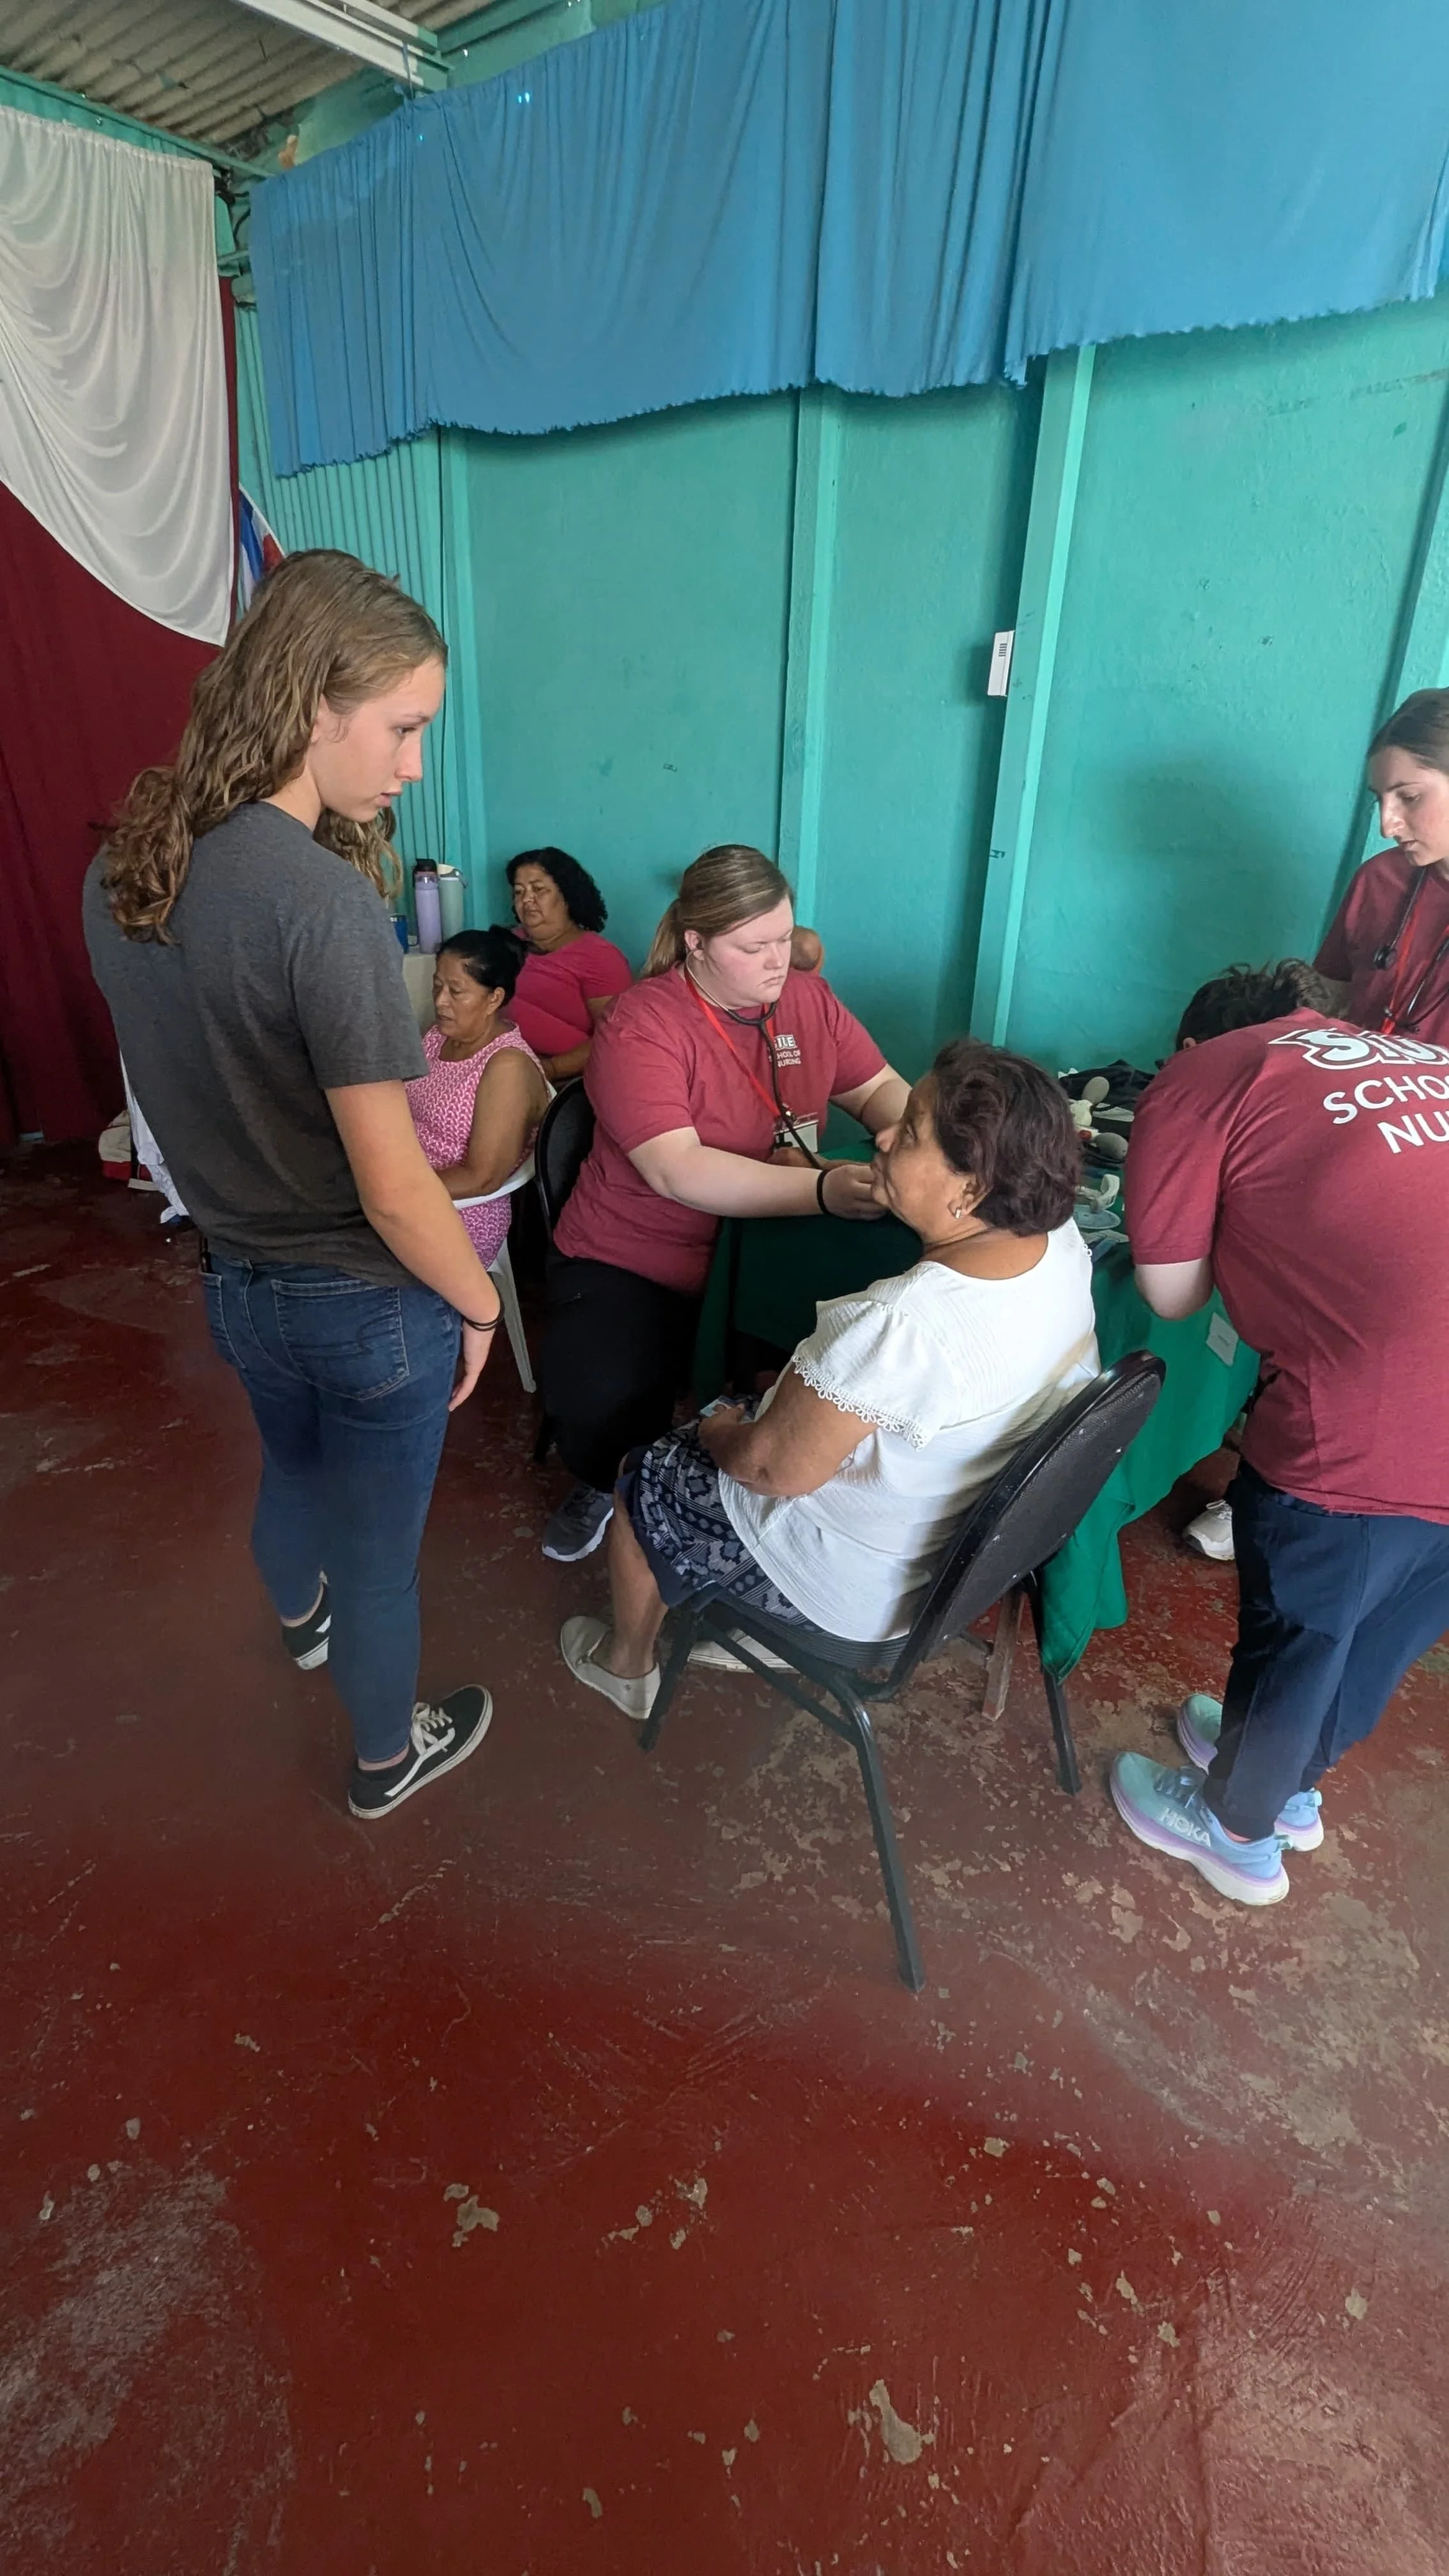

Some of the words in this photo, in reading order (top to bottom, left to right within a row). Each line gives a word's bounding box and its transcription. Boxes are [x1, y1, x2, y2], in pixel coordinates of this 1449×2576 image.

[774, 1034, 798, 1051] IUE
[1323, 1075, 1449, 1124] SCHO
[1377, 1111, 1449, 1154] NU
[1158, 1807, 1211, 1847] HOKA
